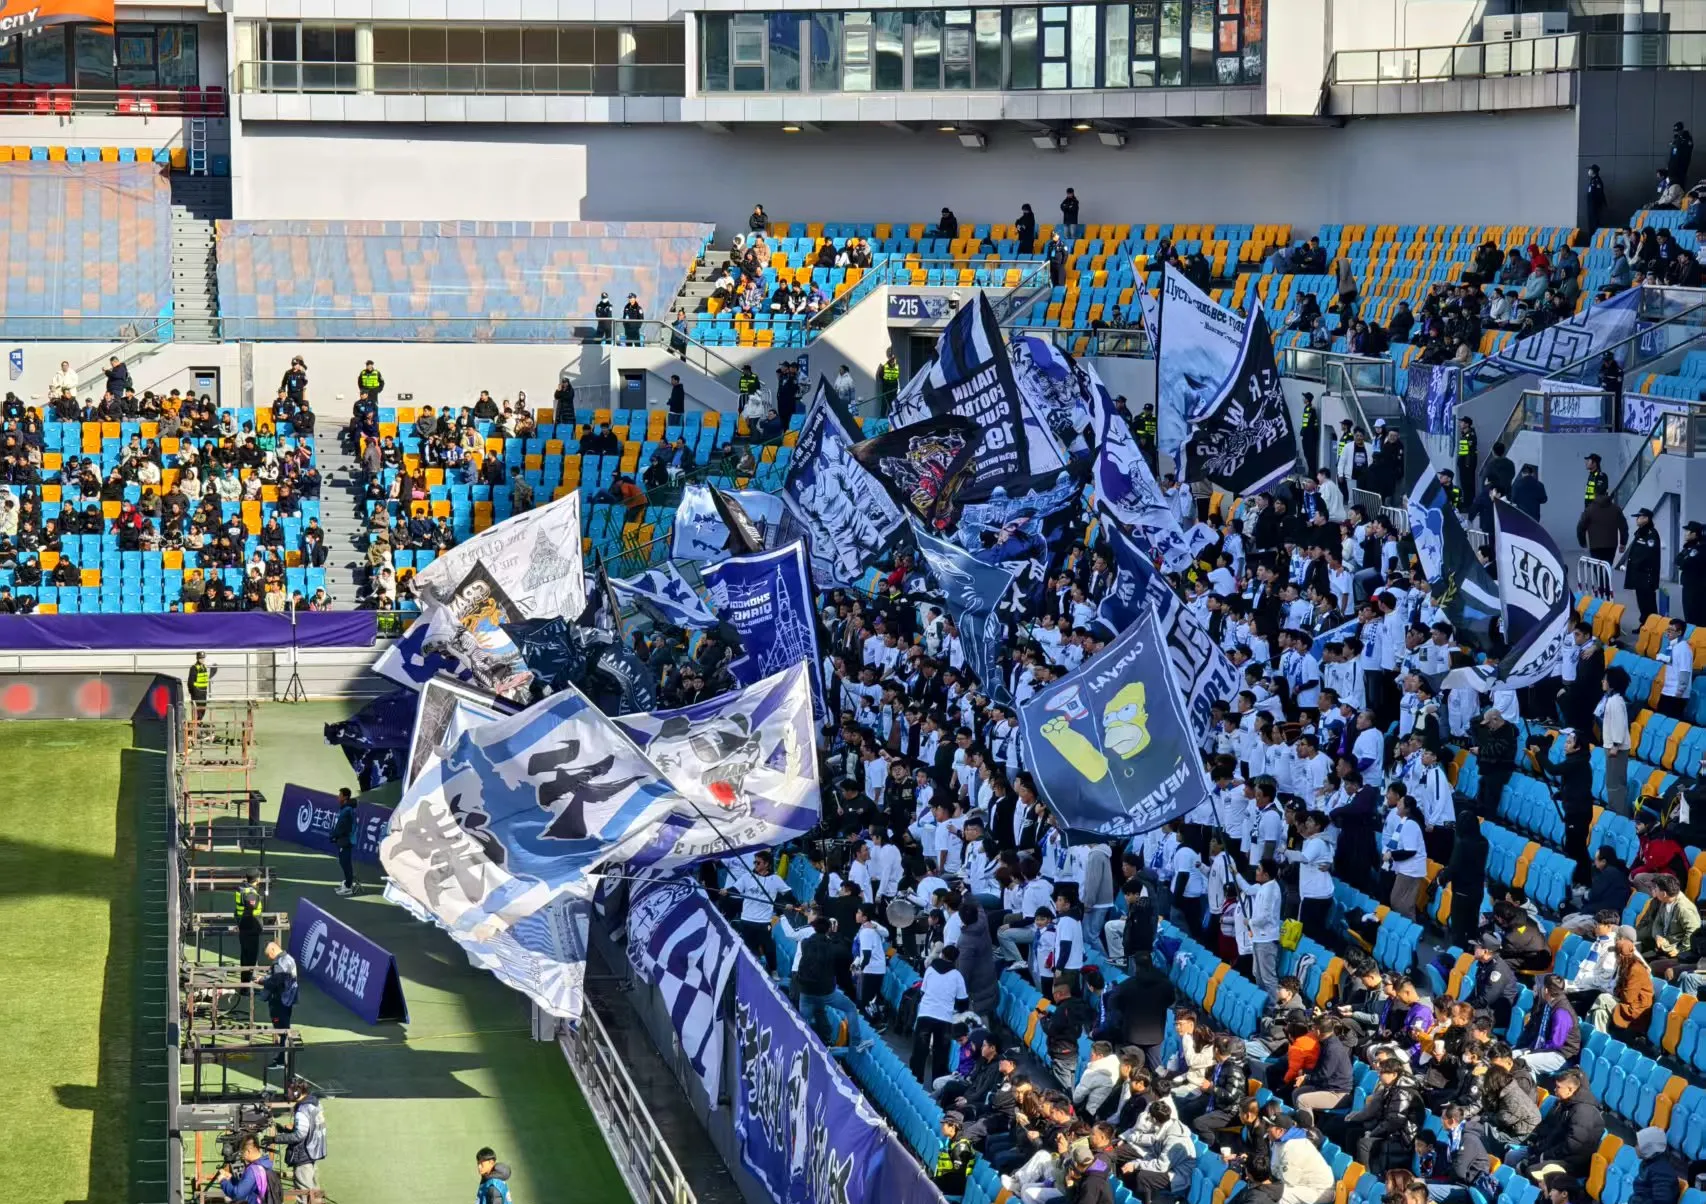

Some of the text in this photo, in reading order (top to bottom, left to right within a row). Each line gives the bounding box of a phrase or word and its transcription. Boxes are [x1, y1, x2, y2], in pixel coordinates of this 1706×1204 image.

[898, 298, 919, 316] 215
[324, 938, 372, 1000] 天保控股
